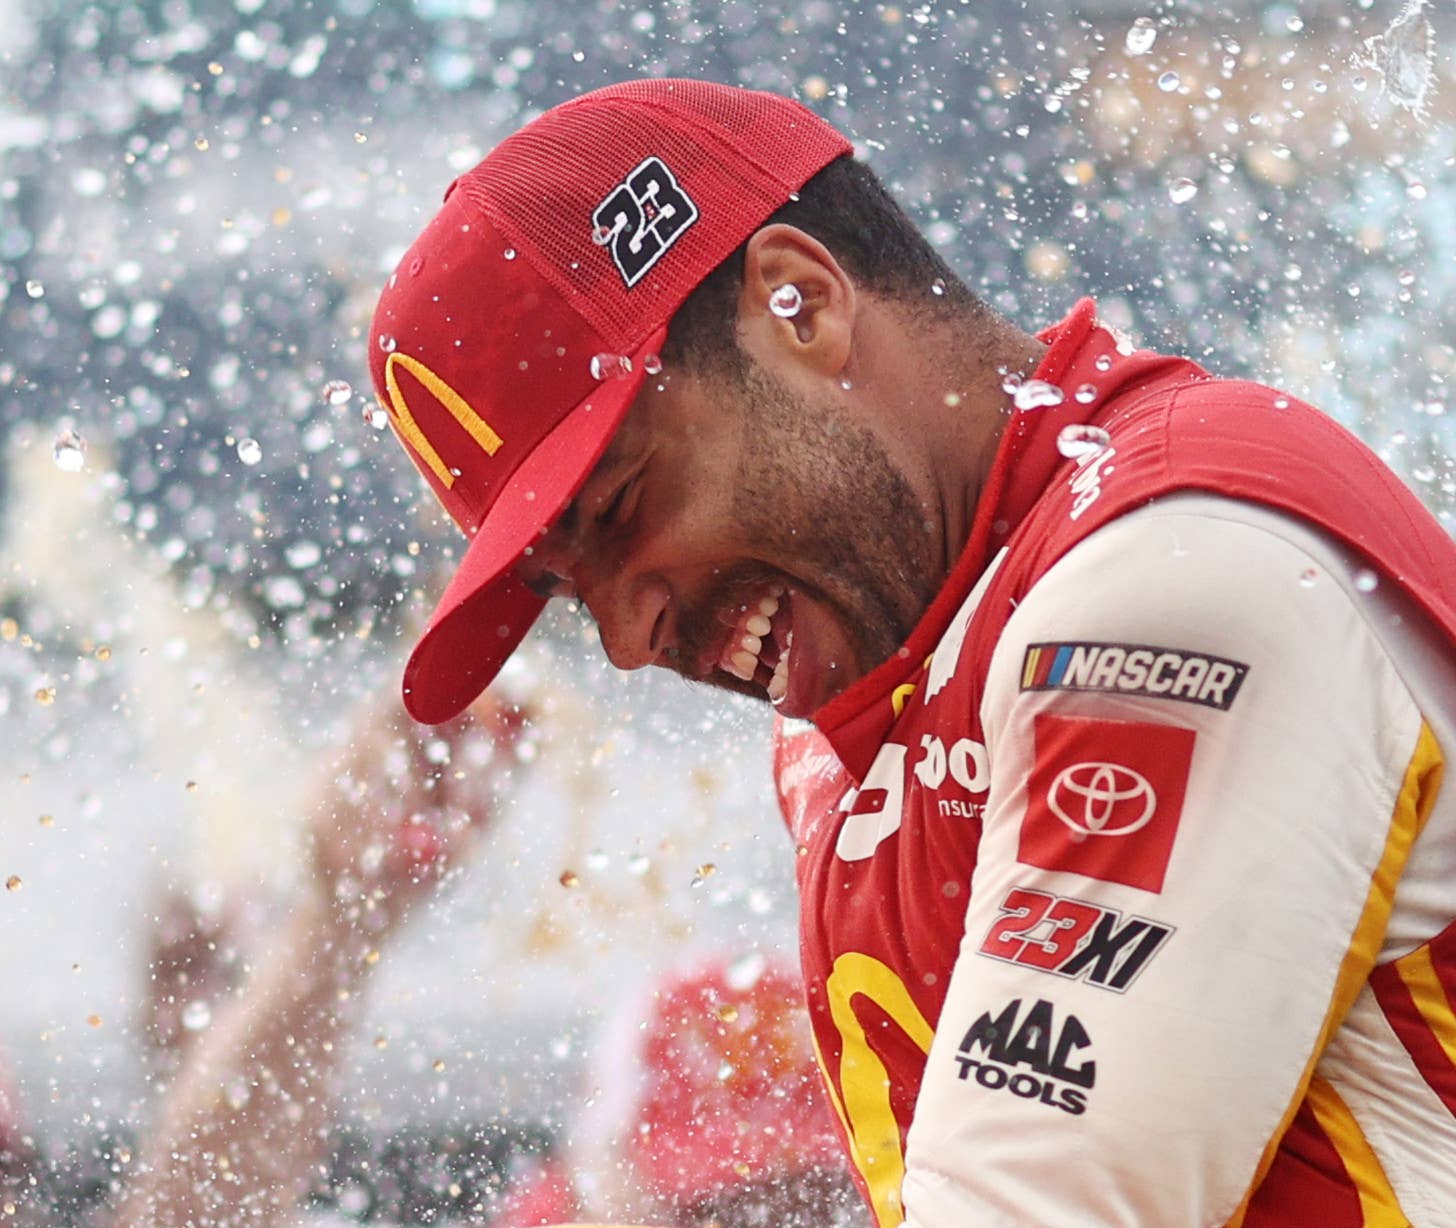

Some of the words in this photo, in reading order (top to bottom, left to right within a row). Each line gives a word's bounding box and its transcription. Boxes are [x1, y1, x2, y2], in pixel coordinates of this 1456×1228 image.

[593, 156, 698, 288] 23
[1062, 646, 1237, 705] NASCAR
[977, 886, 1176, 993] 23XI
[955, 1055, 1088, 1116] TOOLS
[957, 998, 1096, 1090] MAC
